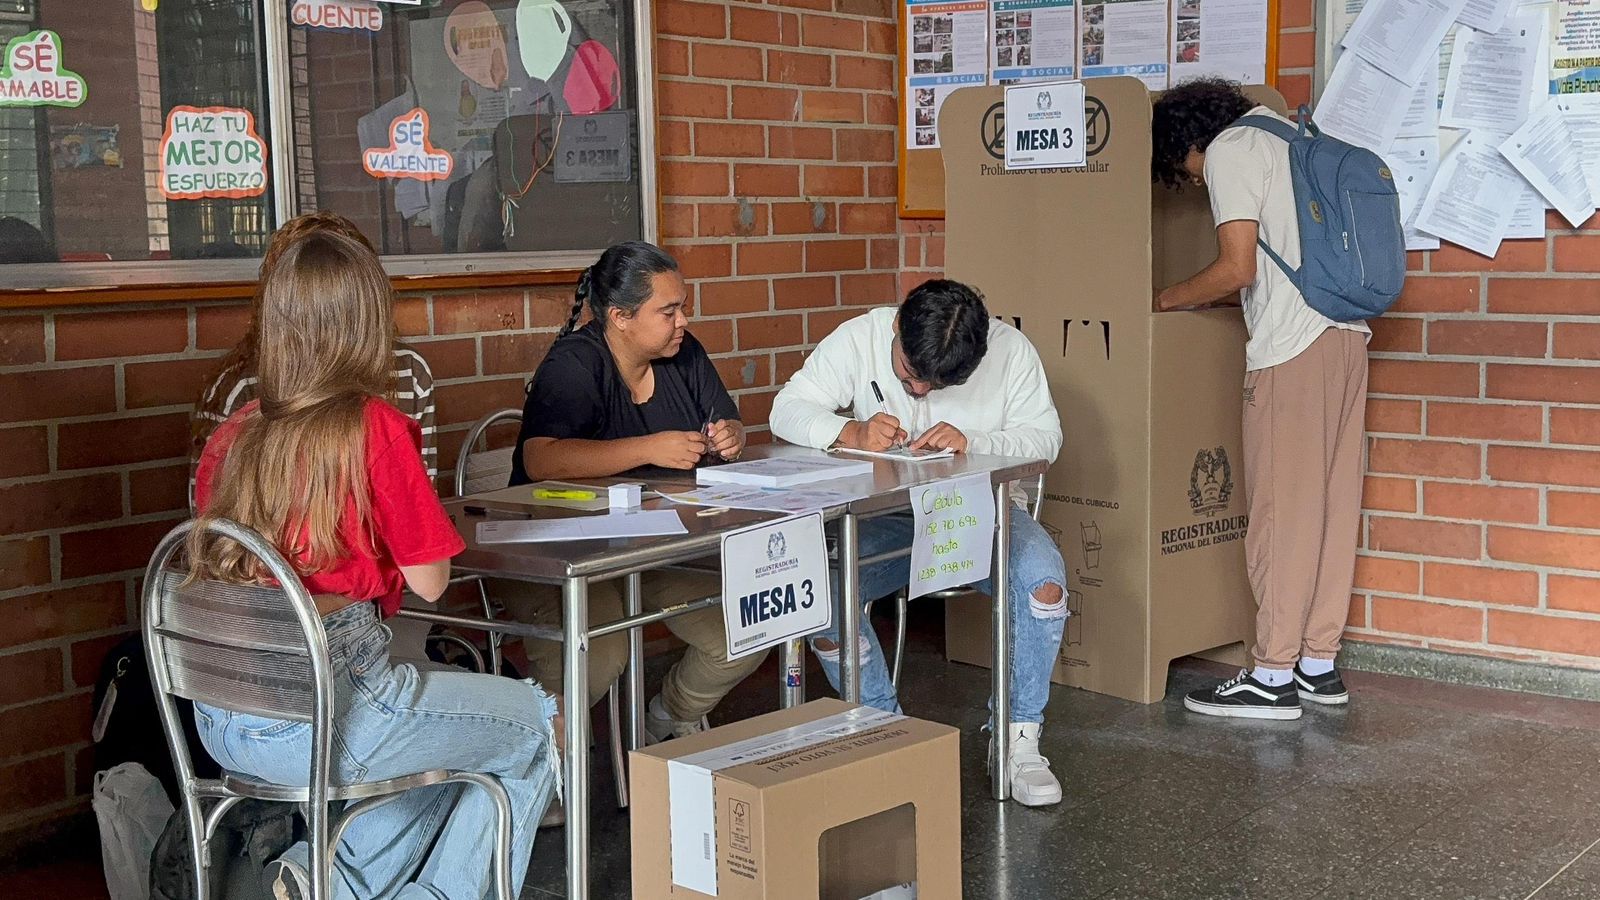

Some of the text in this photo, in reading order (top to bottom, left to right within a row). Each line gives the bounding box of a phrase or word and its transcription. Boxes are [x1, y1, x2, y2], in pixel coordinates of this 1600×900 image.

[293, 3, 380, 29] CUENTE
[13, 34, 53, 72] SÉ
[1032, 68, 1070, 76] SOCIAL
[1123, 65, 1165, 74] SOCIAL
[0, 80, 78, 99] AMABLE
[175, 116, 246, 133] HAZ TU
[395, 113, 422, 145] SÉ
[1016, 127, 1073, 151] MESA 3
[167, 140, 262, 166] MEJOR
[369, 154, 447, 172] VALIENTE
[168, 172, 263, 191] ESFUERZO
[1043, 493, 1070, 503] ARMADO
[1071, 497, 1084, 505] DEL
[958, 515, 977, 528] 693
[1161, 514, 1250, 545] REGISTRADURI
[932, 538, 958, 554] hasta
[1161, 540, 1196, 555] NACIONAL
[1197, 537, 1211, 548] DEL
[1213, 531, 1239, 544] ESTADO
[739, 579, 815, 628] MESA 3
